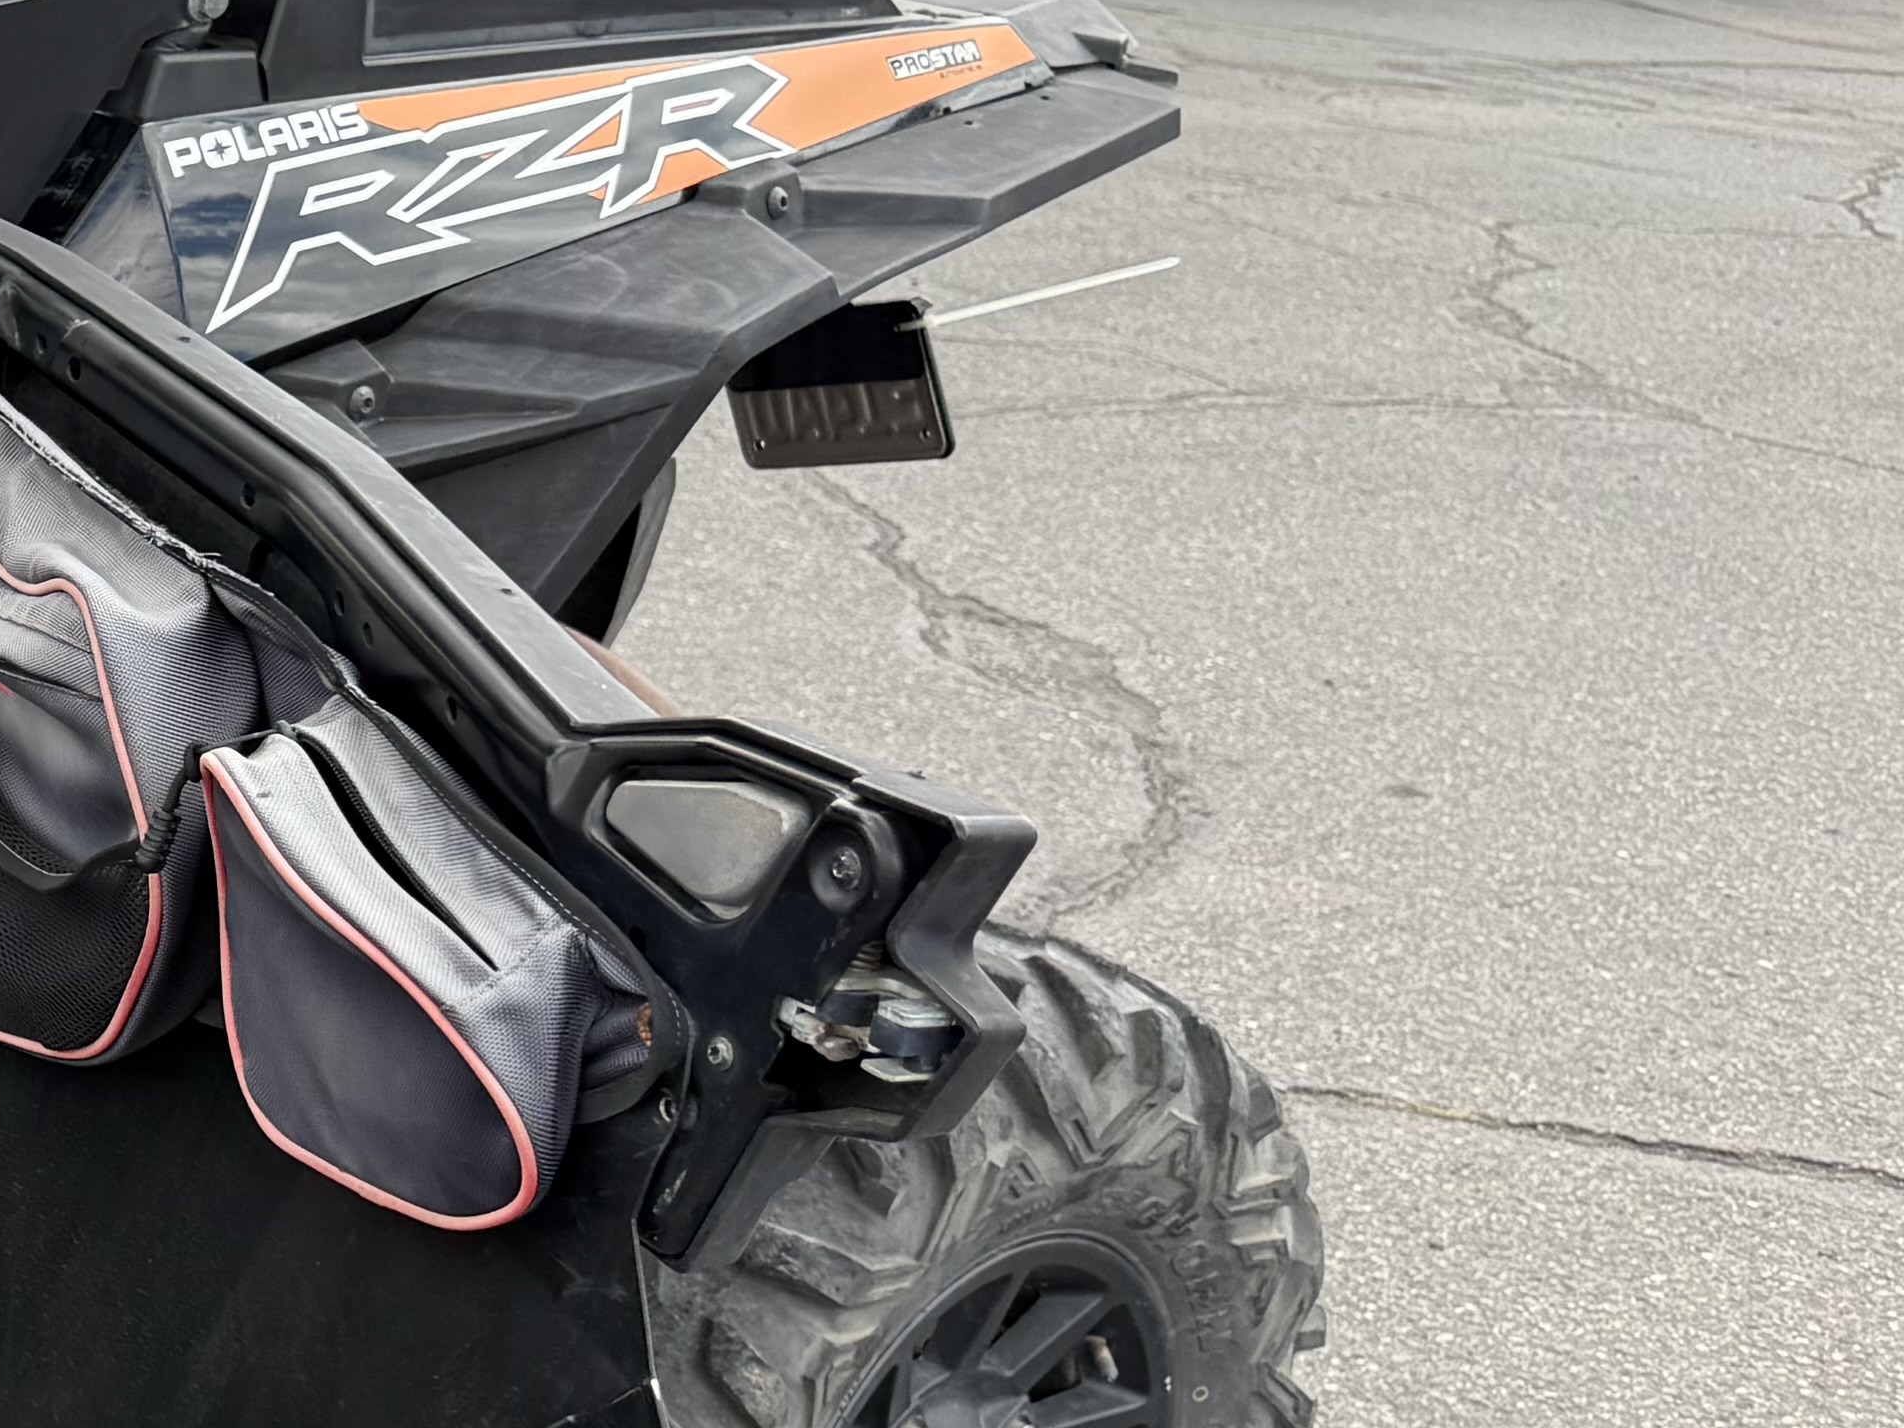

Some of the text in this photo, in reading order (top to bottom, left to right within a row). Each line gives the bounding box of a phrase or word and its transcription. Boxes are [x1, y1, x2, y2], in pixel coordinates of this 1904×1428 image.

[886, 38, 983, 80] PROSTAR
[163, 102, 370, 179] POLARIS
[206, 56, 798, 335] RZR
